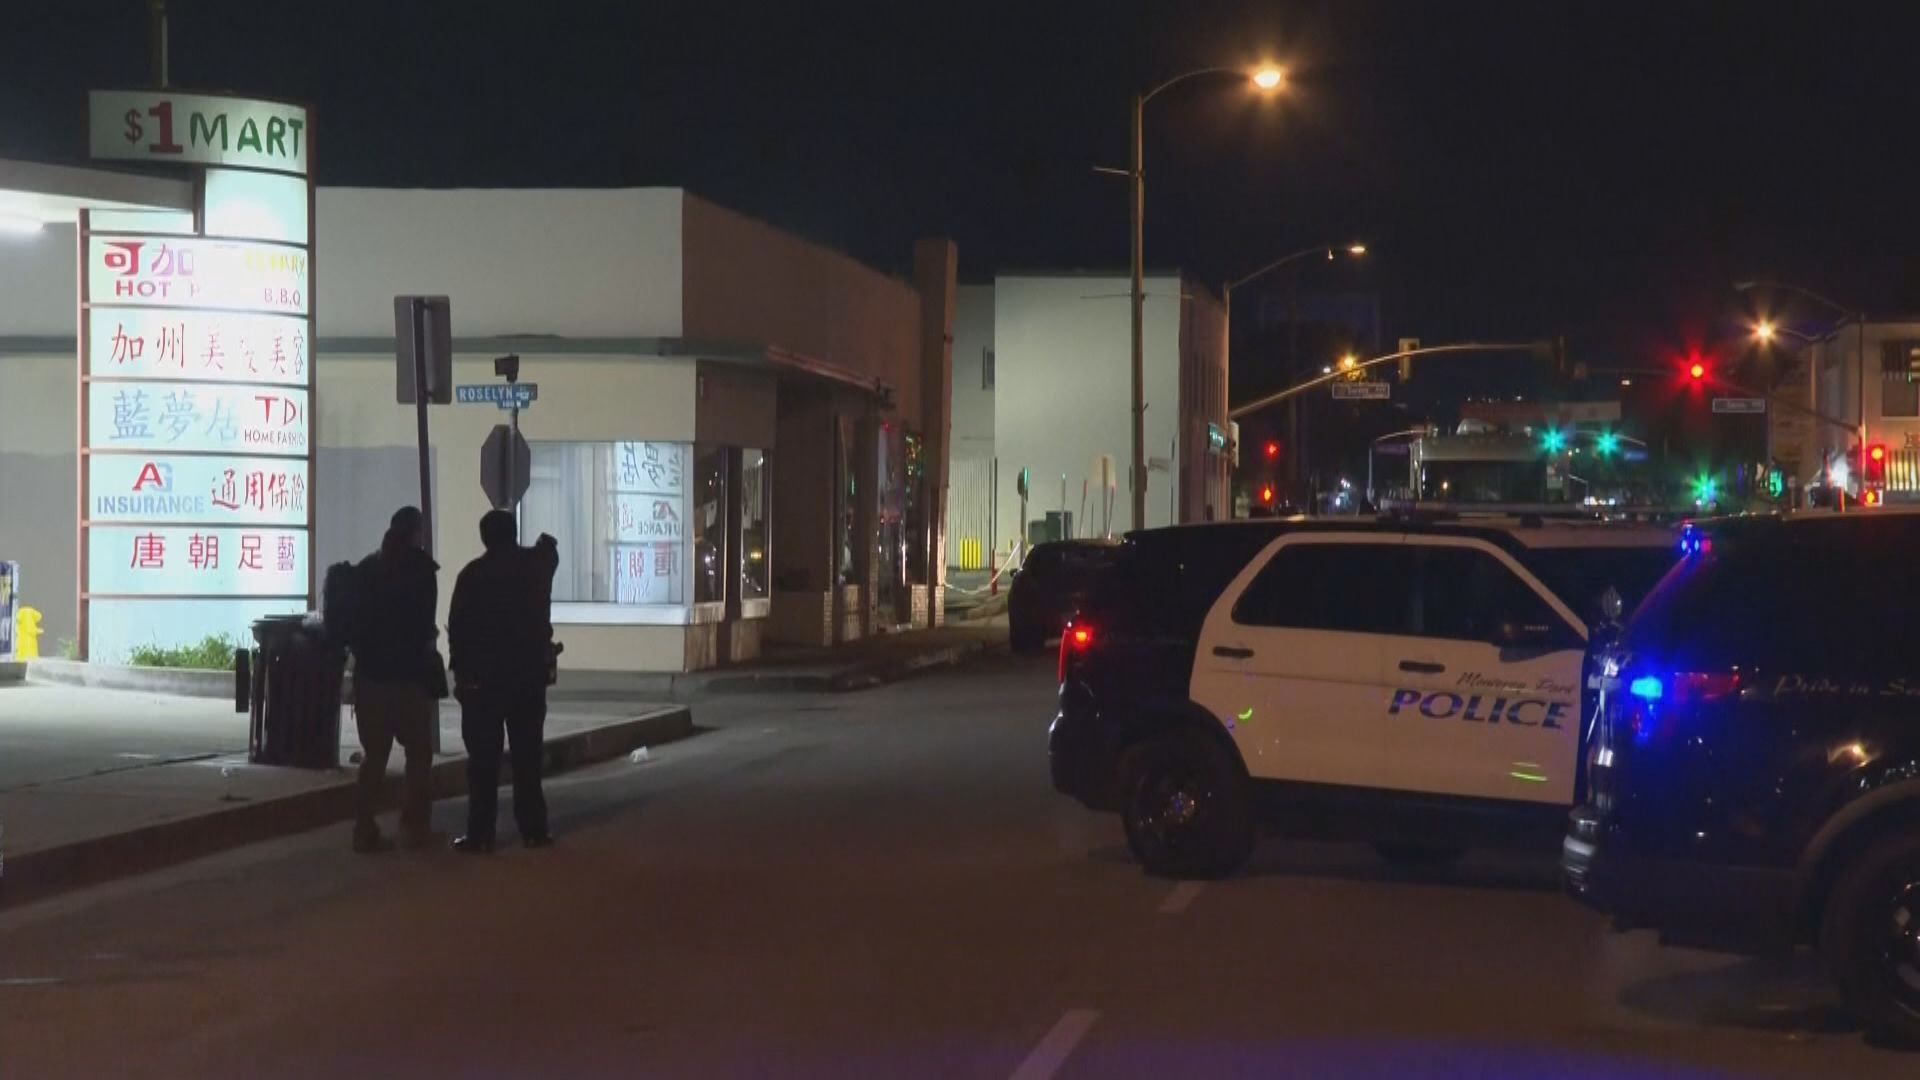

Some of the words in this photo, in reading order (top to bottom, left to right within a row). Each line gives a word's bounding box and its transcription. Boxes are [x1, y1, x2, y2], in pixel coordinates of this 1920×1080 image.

[124, 101, 183, 155] $1
[189, 112, 304, 159] MART
[115, 279, 172, 298] HOT
[458, 385, 513, 402] ROSELYN
[244, 429, 275, 444] HOME
[211, 468, 305, 512] 通用保險
[97, 496, 204, 514] INSURANCE
[130, 532, 296, 572] 唐朝足藝
[1388, 688, 1573, 730] POLICE
